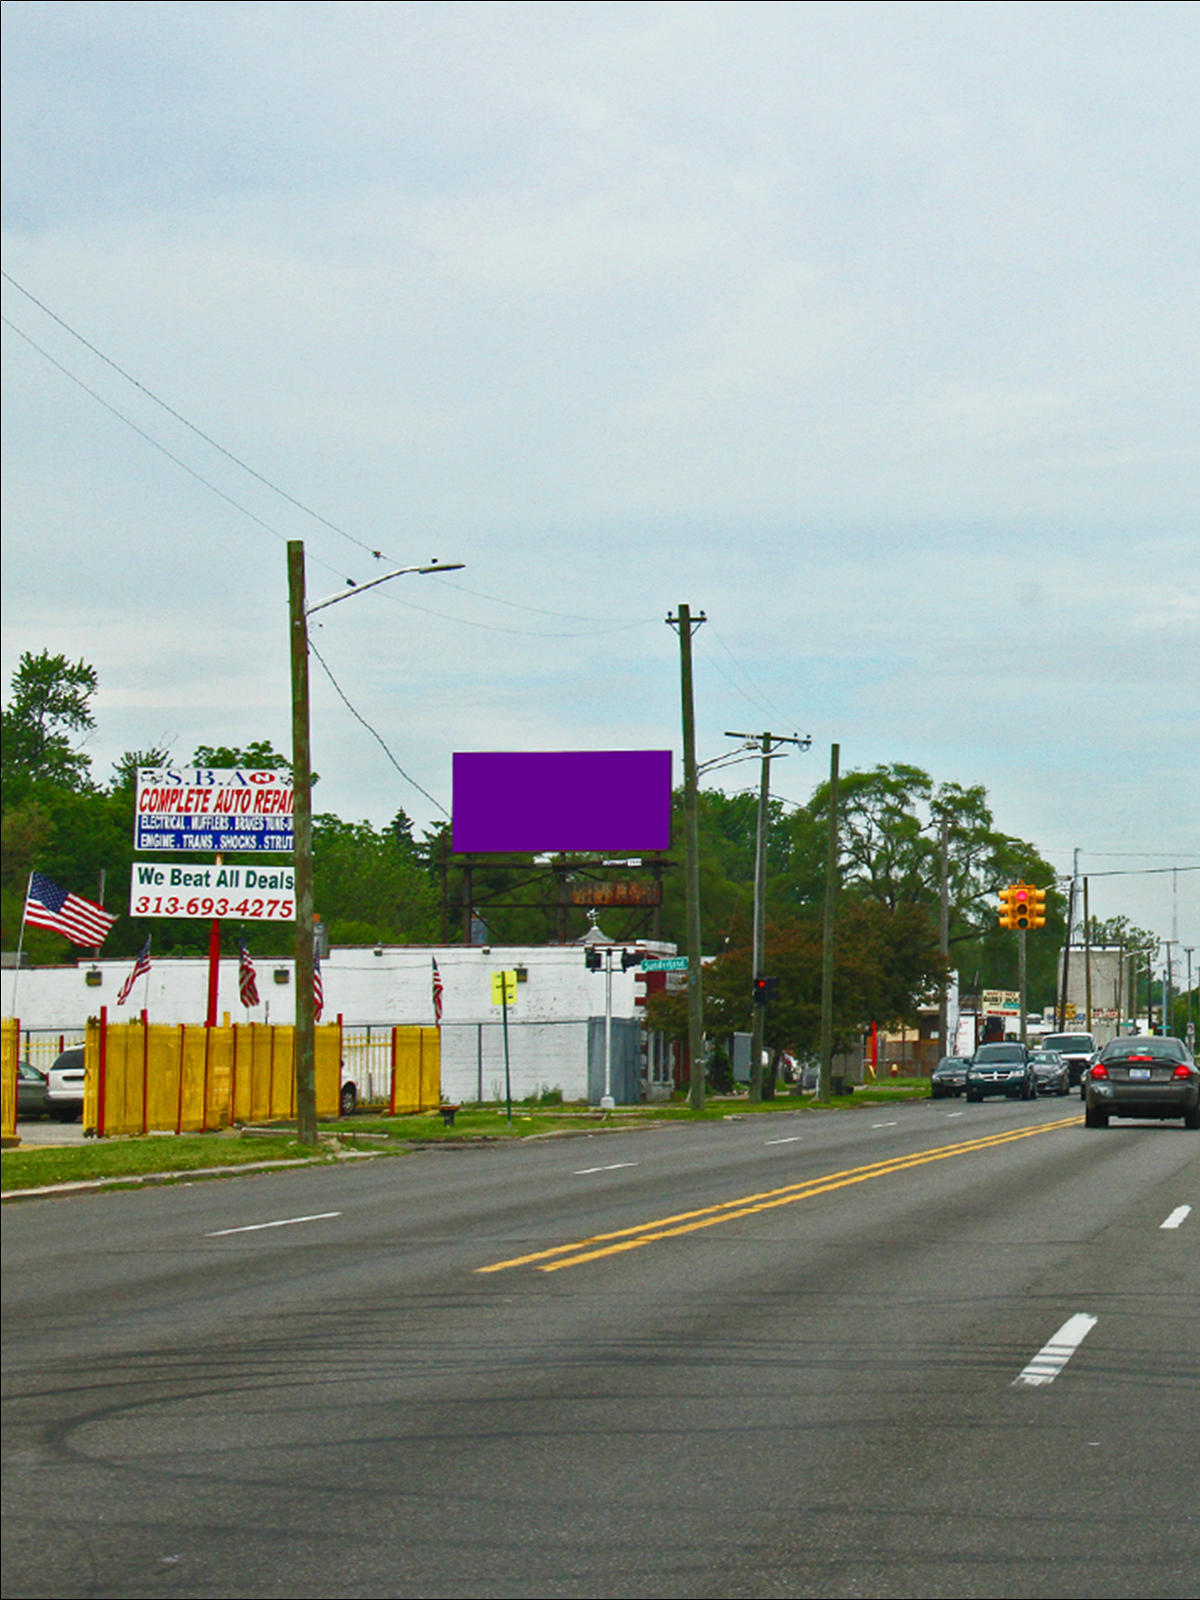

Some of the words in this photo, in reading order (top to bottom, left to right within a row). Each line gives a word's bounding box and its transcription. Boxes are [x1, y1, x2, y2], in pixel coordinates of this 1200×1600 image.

[139, 788, 212, 813] COMPLETE
[213, 788, 252, 814] AUTO
[253, 789, 295, 814] REPAI
[141, 816, 186, 830] ELECTRICAL
[191, 817, 229, 831] MUFFLERS
[235, 817, 264, 831] BRAKES
[140, 833, 176, 849] ENGINE
[182, 834, 213, 849] TRANS
[219, 835, 257, 849] SHOCKS
[138, 867, 165, 885] We
[170, 868, 211, 887] Beat
[216, 870, 239, 888] All
[245, 871, 294, 889] Deals
[135, 896, 294, 918] 313-693-4275
